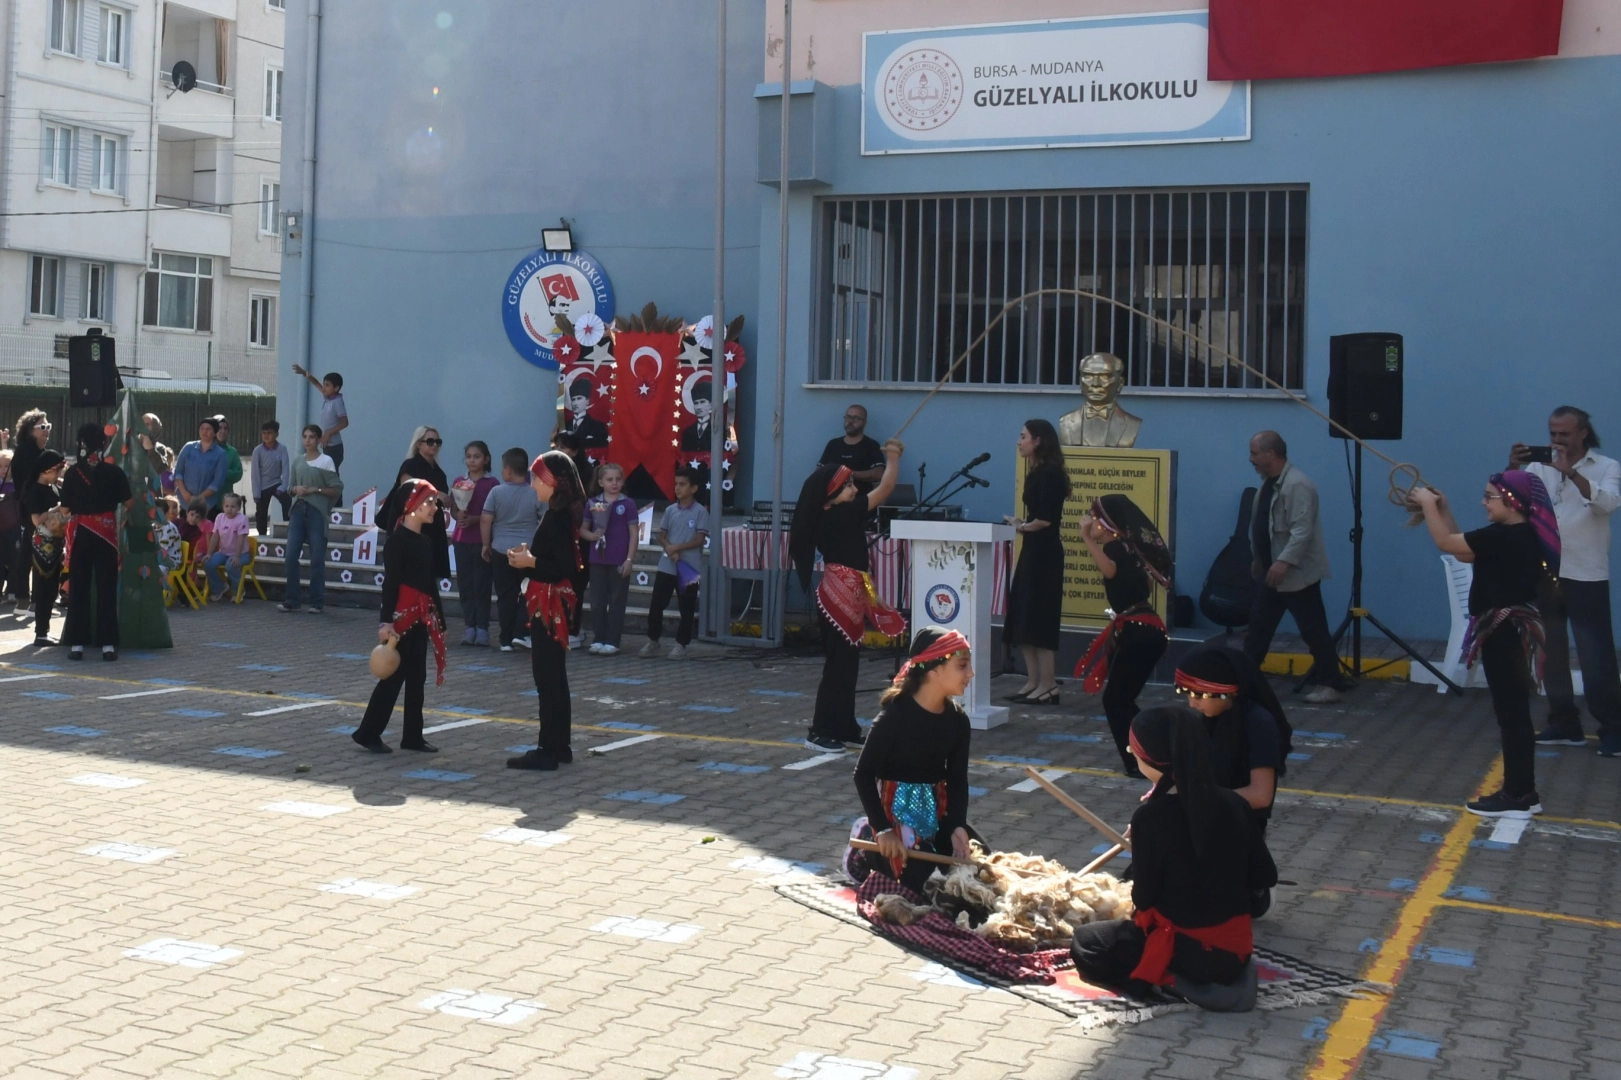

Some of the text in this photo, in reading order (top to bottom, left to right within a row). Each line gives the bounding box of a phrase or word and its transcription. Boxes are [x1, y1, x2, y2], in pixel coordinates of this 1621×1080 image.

[974, 65, 1018, 79] BURSA
[1030, 60, 1104, 76] MUDANYA
[974, 79, 1198, 107] GÜZELYALI İLKOKULU
[508, 252, 557, 305] GÜZELYALI
[534, 348, 557, 361] MUD
[1098, 467, 1120, 478] KÜÇÜK
[1122, 469, 1146, 477] BEYLER!
[1063, 508, 1083, 516] LULUK
[1079, 563, 1101, 572] OLDU
